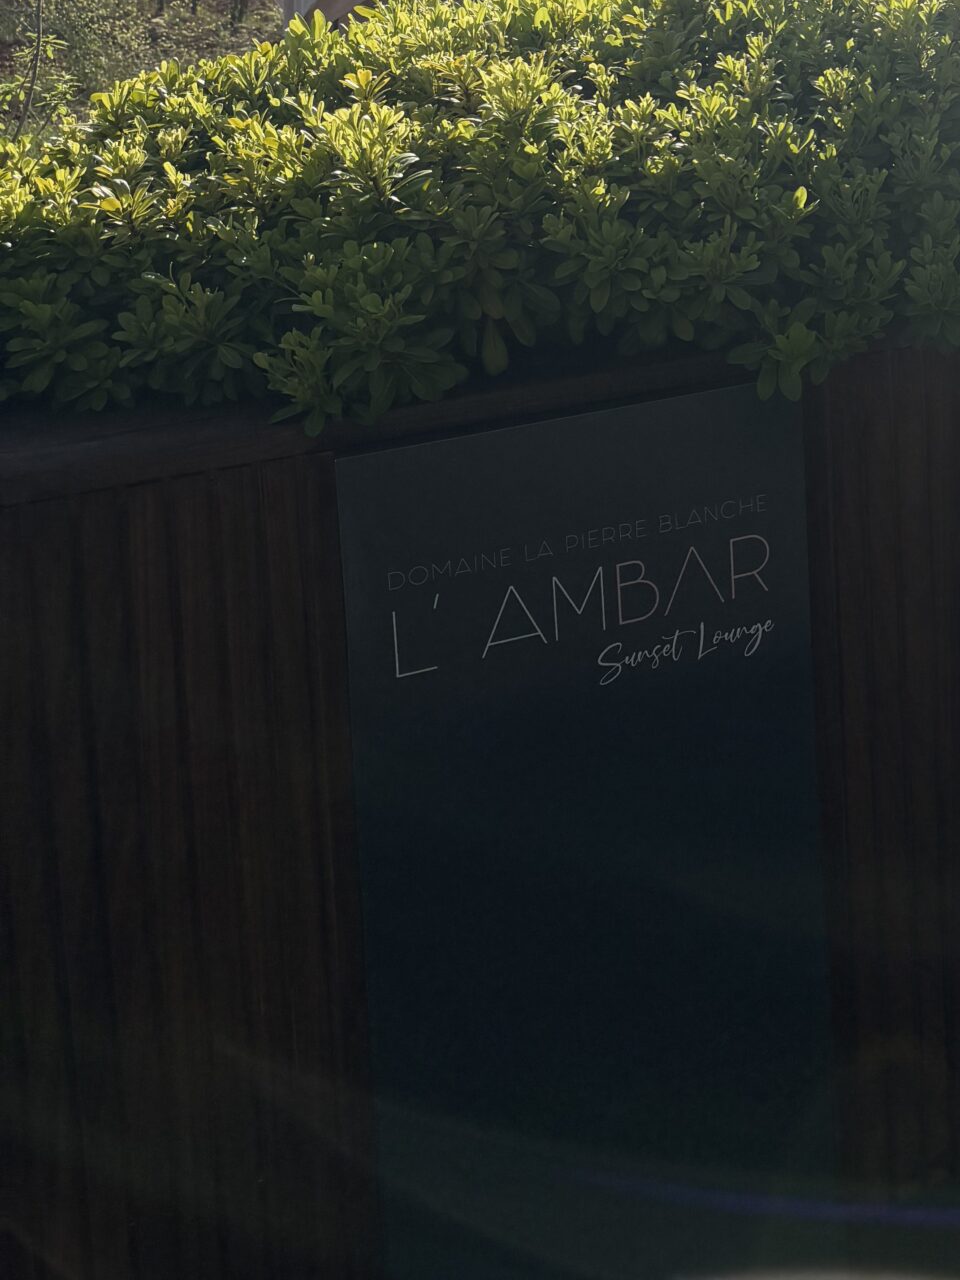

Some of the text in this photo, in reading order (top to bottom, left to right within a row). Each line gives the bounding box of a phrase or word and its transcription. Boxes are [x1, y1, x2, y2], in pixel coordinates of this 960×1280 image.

[387, 493, 768, 592] DOMAINE LA PIERRE BLANCHE
[481, 533, 771, 659] AMBAR
[597, 618, 775, 686] Sunset Lounge
